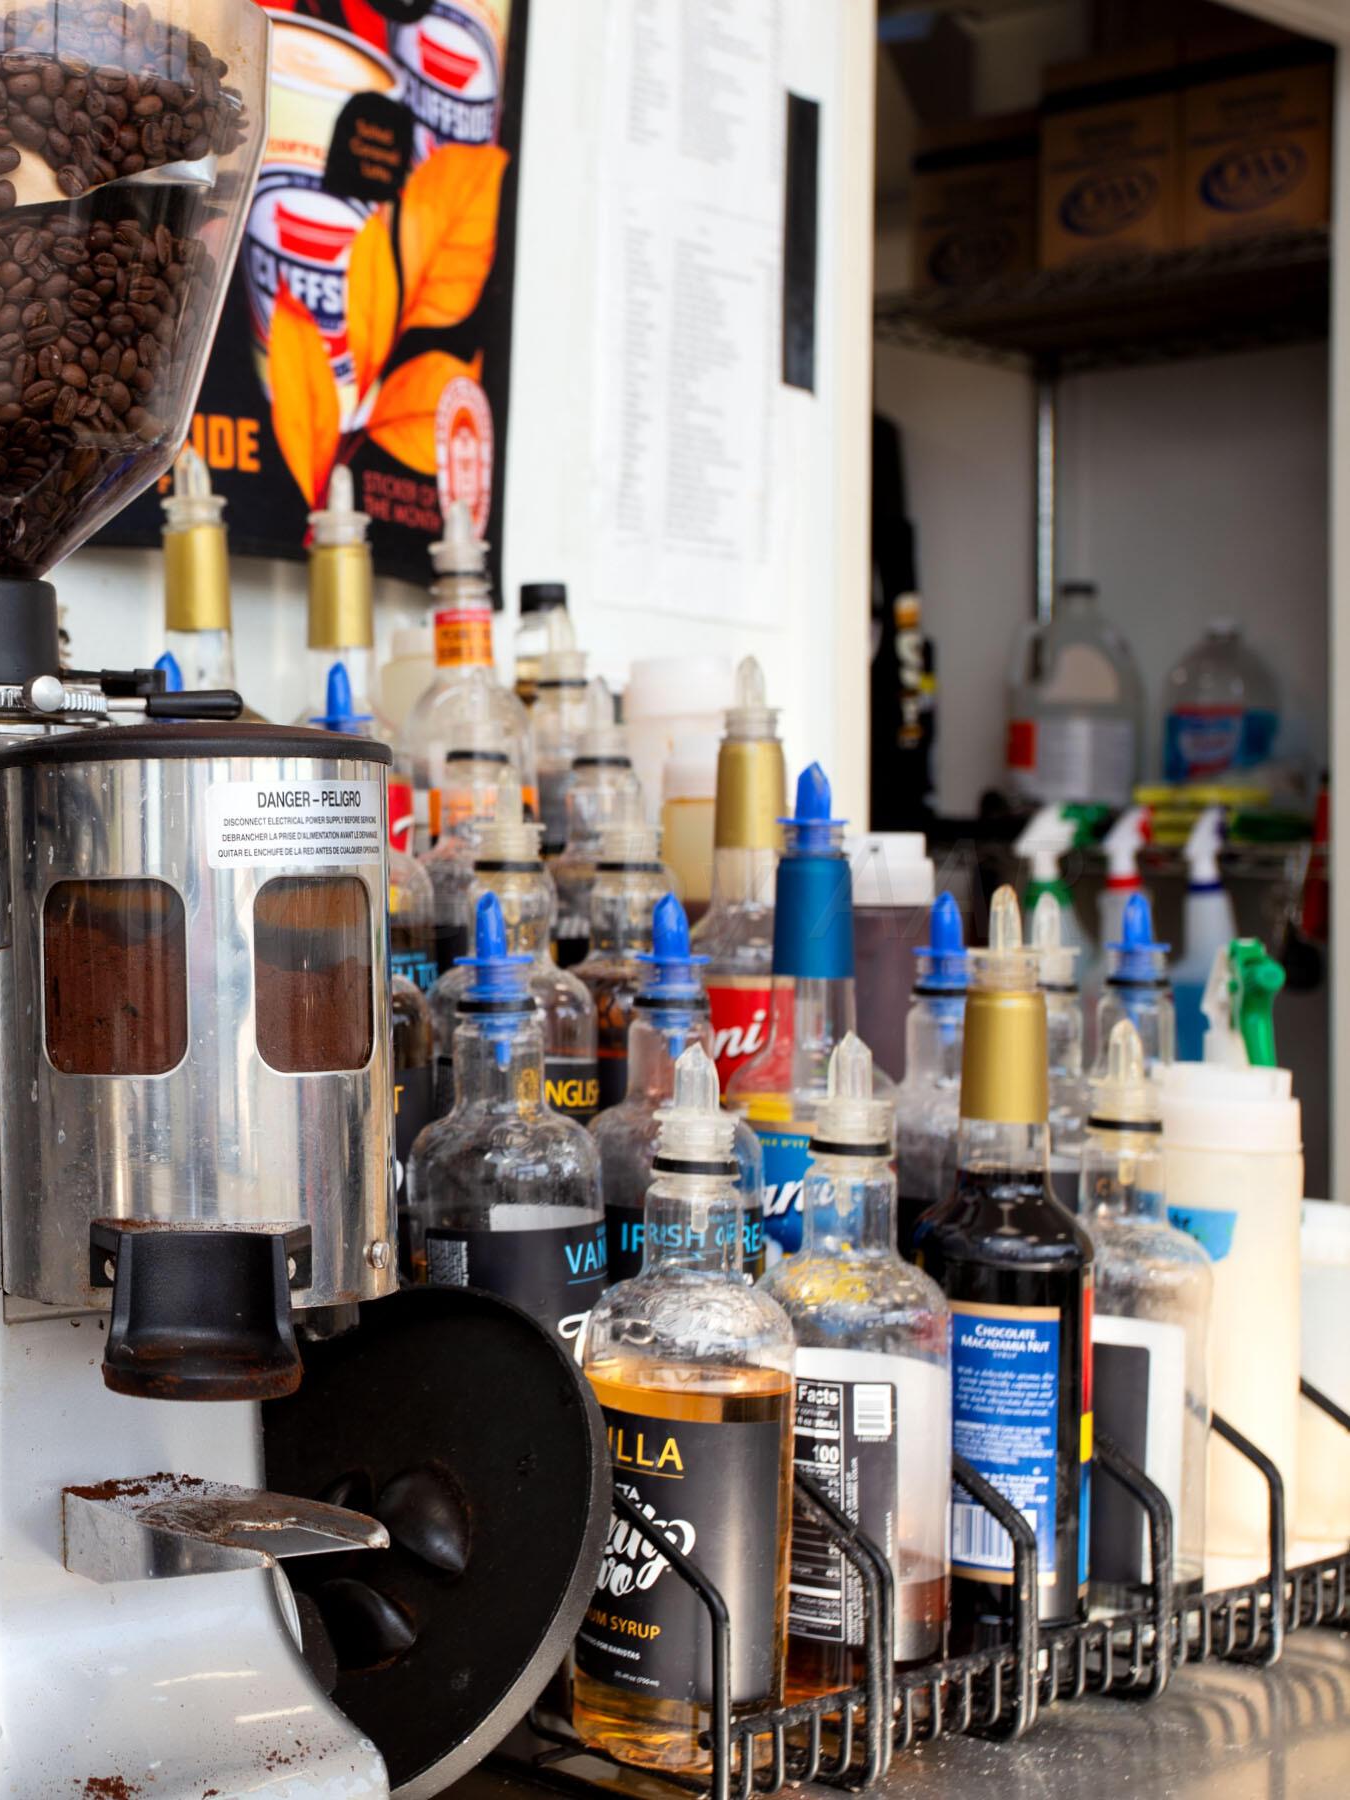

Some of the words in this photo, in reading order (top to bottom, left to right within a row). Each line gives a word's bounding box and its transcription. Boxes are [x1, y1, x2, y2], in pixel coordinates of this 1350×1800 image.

[257, 791, 311, 808] DANGER
[321, 790, 361, 807] PELIGRO
[223, 816, 266, 827] DISCONNECT
[267, 816, 305, 825] ELECTRICAL
[305, 815, 325, 825] POWER
[325, 815, 344, 825] SUPPLY
[344, 815, 361, 825] BEFORE
[221, 832, 268, 842] DEBRANCHER
[269, 831, 278, 841] LA
[278, 831, 296, 841] PRISE
[340, 830, 353, 840] AVANT
[217, 848, 243, 858] QUITAR
[244, 848, 253, 857] EL
[253, 847, 284, 857] ENCHUFE
[284, 847, 293, 856] DE
[293, 847, 302, 856] LA
[302, 846, 315, 855] RED
[315, 846, 332, 855] ANTES
[333, 846, 339, 855] DE
[797, 1384, 840, 1406] Facts
[811, 1444, 840, 1463] 100
[610, 1616, 661, 1640] SYRUP
